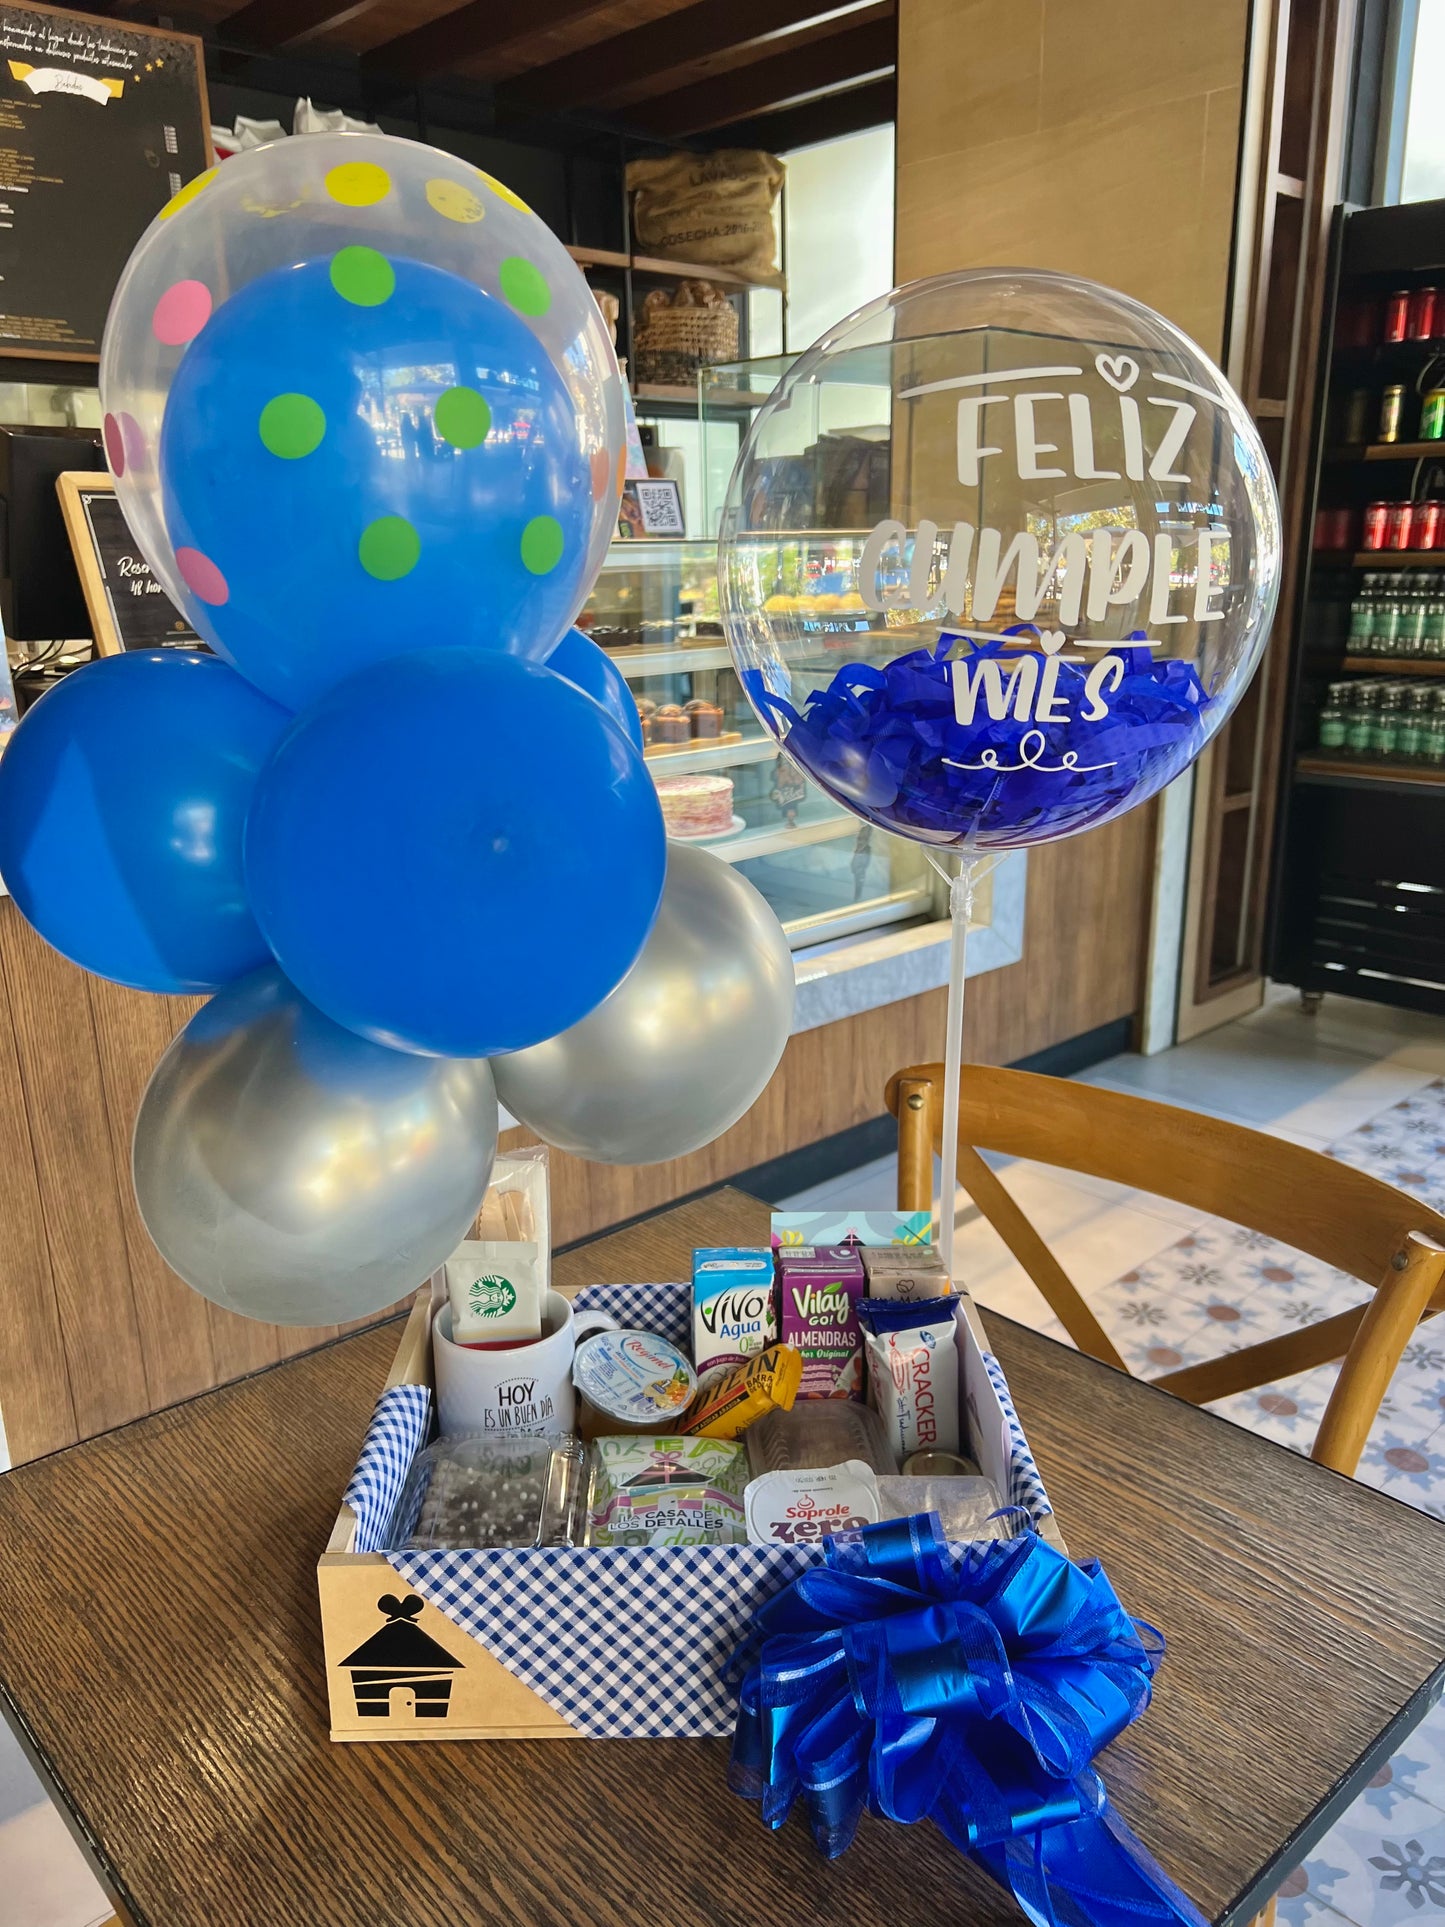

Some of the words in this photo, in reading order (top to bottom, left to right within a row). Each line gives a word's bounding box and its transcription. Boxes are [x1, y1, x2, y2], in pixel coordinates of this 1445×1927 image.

[957, 392, 1198, 486] FELIZ
[117, 556, 151, 577] Reser
[858, 519, 1232, 627] CUMPLE
[145, 578, 167, 595] hor
[791, 1284, 850, 1324] Vilay
[720, 1320, 761, 1341] Agua
[808, 1315, 833, 1326] GO!
[788, 1330, 856, 1347] ALMENDRAS
[626, 1341, 675, 1370] Regimel
[816, 1349, 850, 1359] Original
[498, 1381, 535, 1407] HOY
[911, 1347, 936, 1446] CRACKER
[484, 1408, 496, 1428] ES
[498, 1408, 512, 1428] UN
[515, 1403, 538, 1426] BUEN
[540, 1394, 553, 1418] DÍA
[645, 1509, 687, 1519] CASA
[693, 1510, 713, 1520] DE
[785, 1504, 850, 1520] Soprole
[610, 1522, 639, 1531] LOS
[645, 1518, 724, 1530] DETALLES
[770, 1516, 869, 1538] zero
